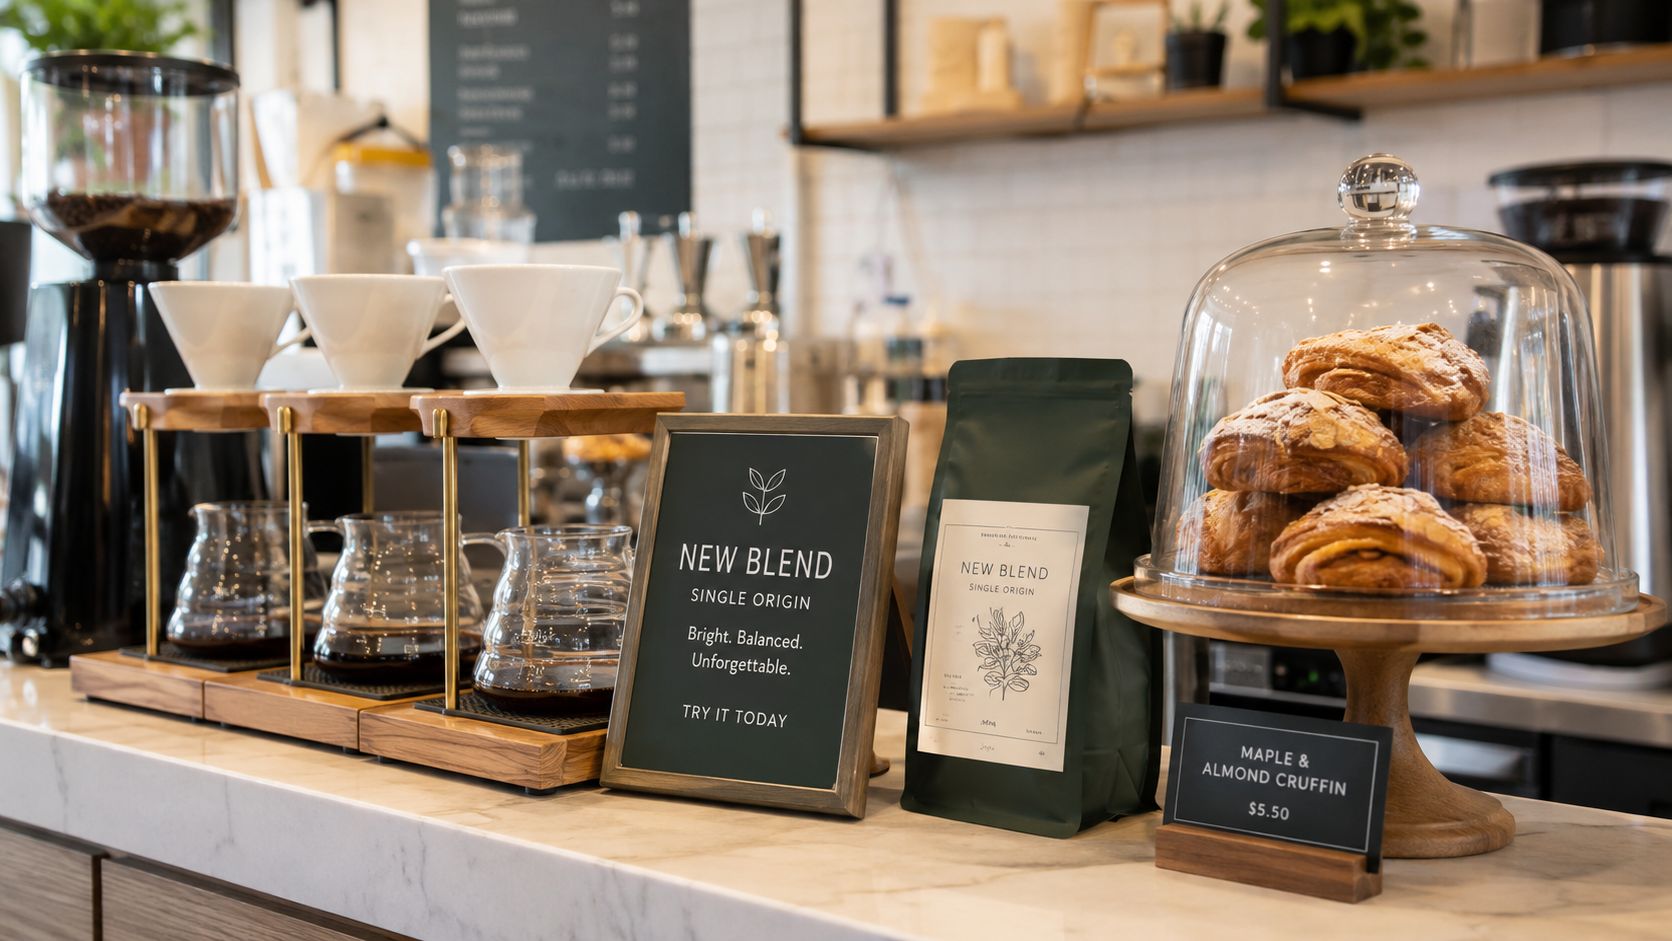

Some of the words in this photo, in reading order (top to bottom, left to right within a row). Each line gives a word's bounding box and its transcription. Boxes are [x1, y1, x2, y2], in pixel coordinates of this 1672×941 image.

[679, 543, 738, 574] NEW
[746, 547, 833, 580] BLEND
[960, 561, 994, 576] NEW
[999, 564, 1049, 580] BLEND
[690, 588, 747, 606] SINGLE
[753, 592, 811, 610] ORIGIN
[968, 583, 999, 593] SINGLE
[1003, 585, 1035, 596] ORIGIN
[687, 626, 732, 647] Bright.
[737, 629, 803, 650] Balanced.
[691, 652, 791, 676] Unforgettable.
[682, 704, 711, 720] TRY
[716, 707, 730, 722] IT
[735, 709, 788, 728] TODAY
[1240, 745, 1294, 767] MAPLE
[1298, 753, 1310, 768] &
[1201, 762, 1271, 784] ALMOND
[1275, 772, 1347, 797] CRUFFIN
[1248, 801, 1290, 821] $5.50
